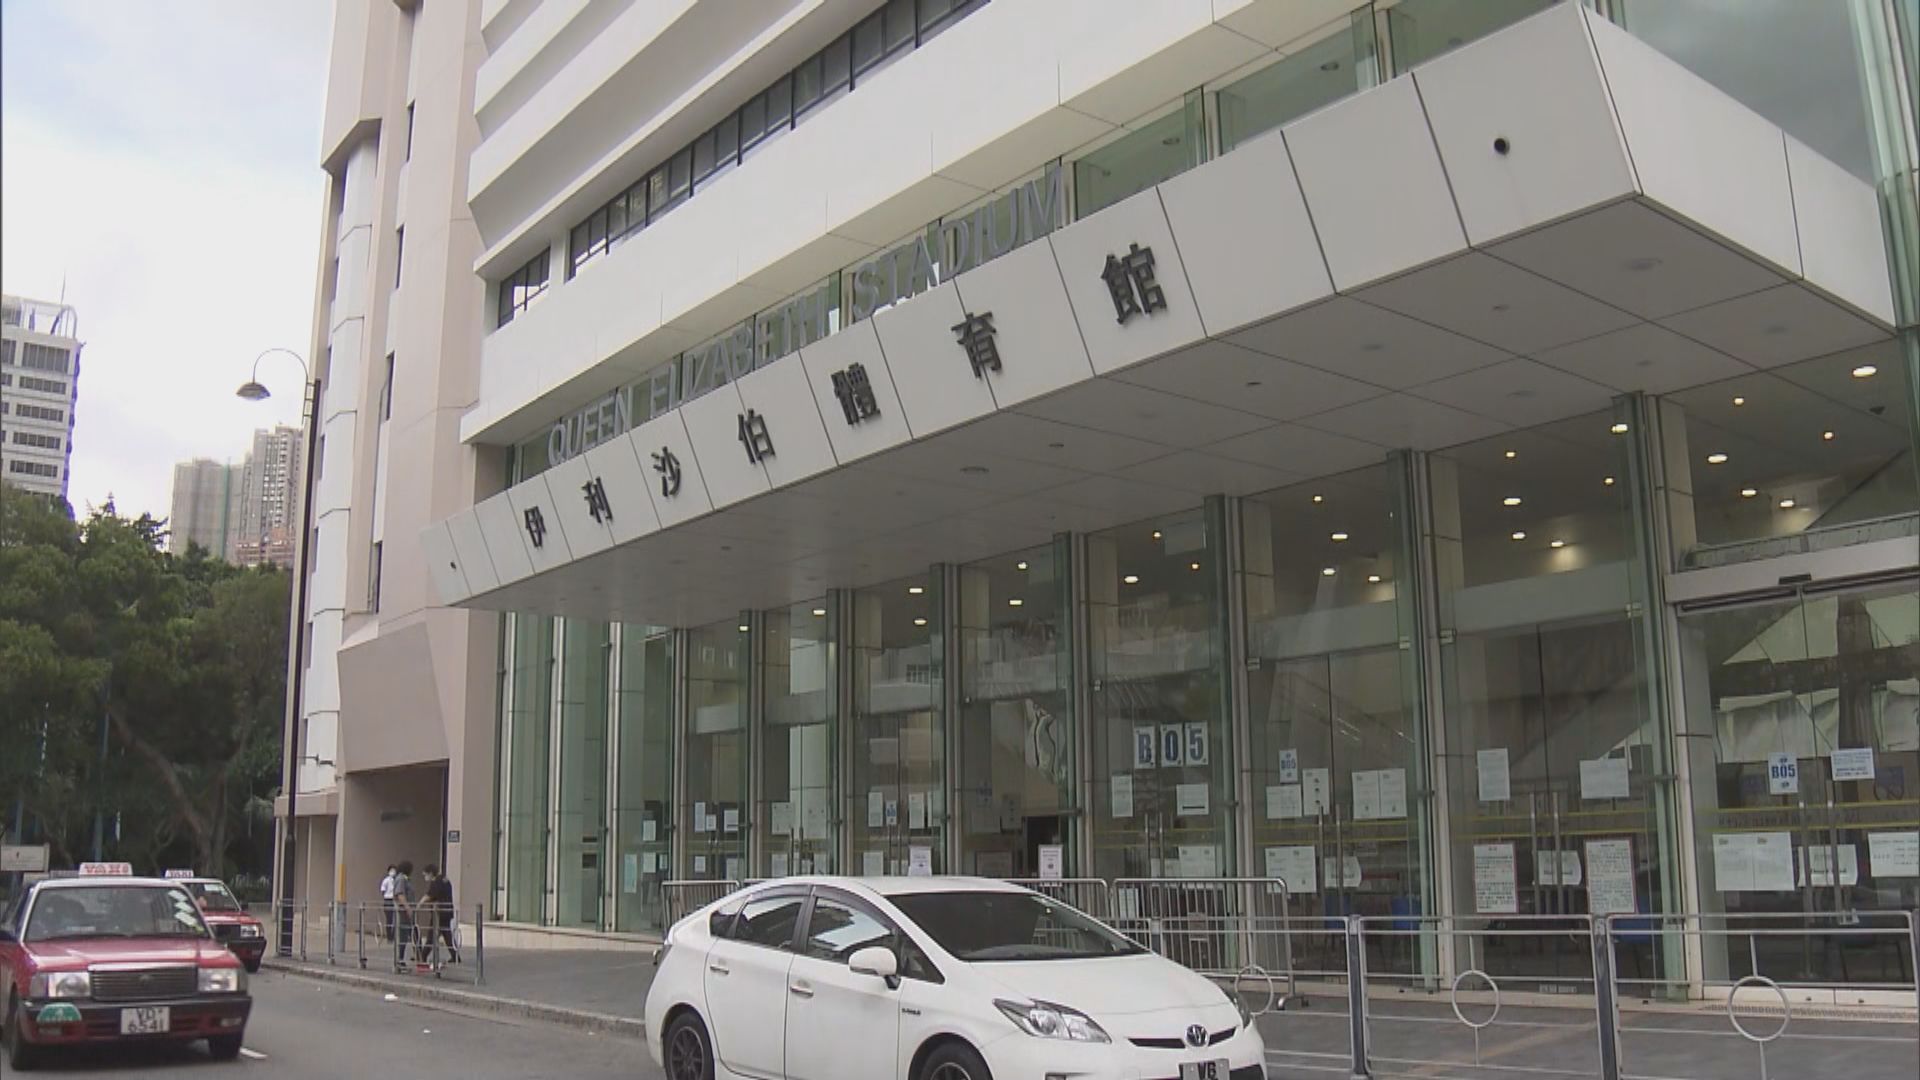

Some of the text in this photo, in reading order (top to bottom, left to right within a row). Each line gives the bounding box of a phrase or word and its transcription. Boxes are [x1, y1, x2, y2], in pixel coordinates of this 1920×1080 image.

[523, 242, 1169, 548] 伊利沙伯體育館
[548, 163, 1063, 465] QUEEN ELIZABETH STADIUM
[1138, 728, 1203, 764] B05
[1771, 764, 1796, 779] B05
